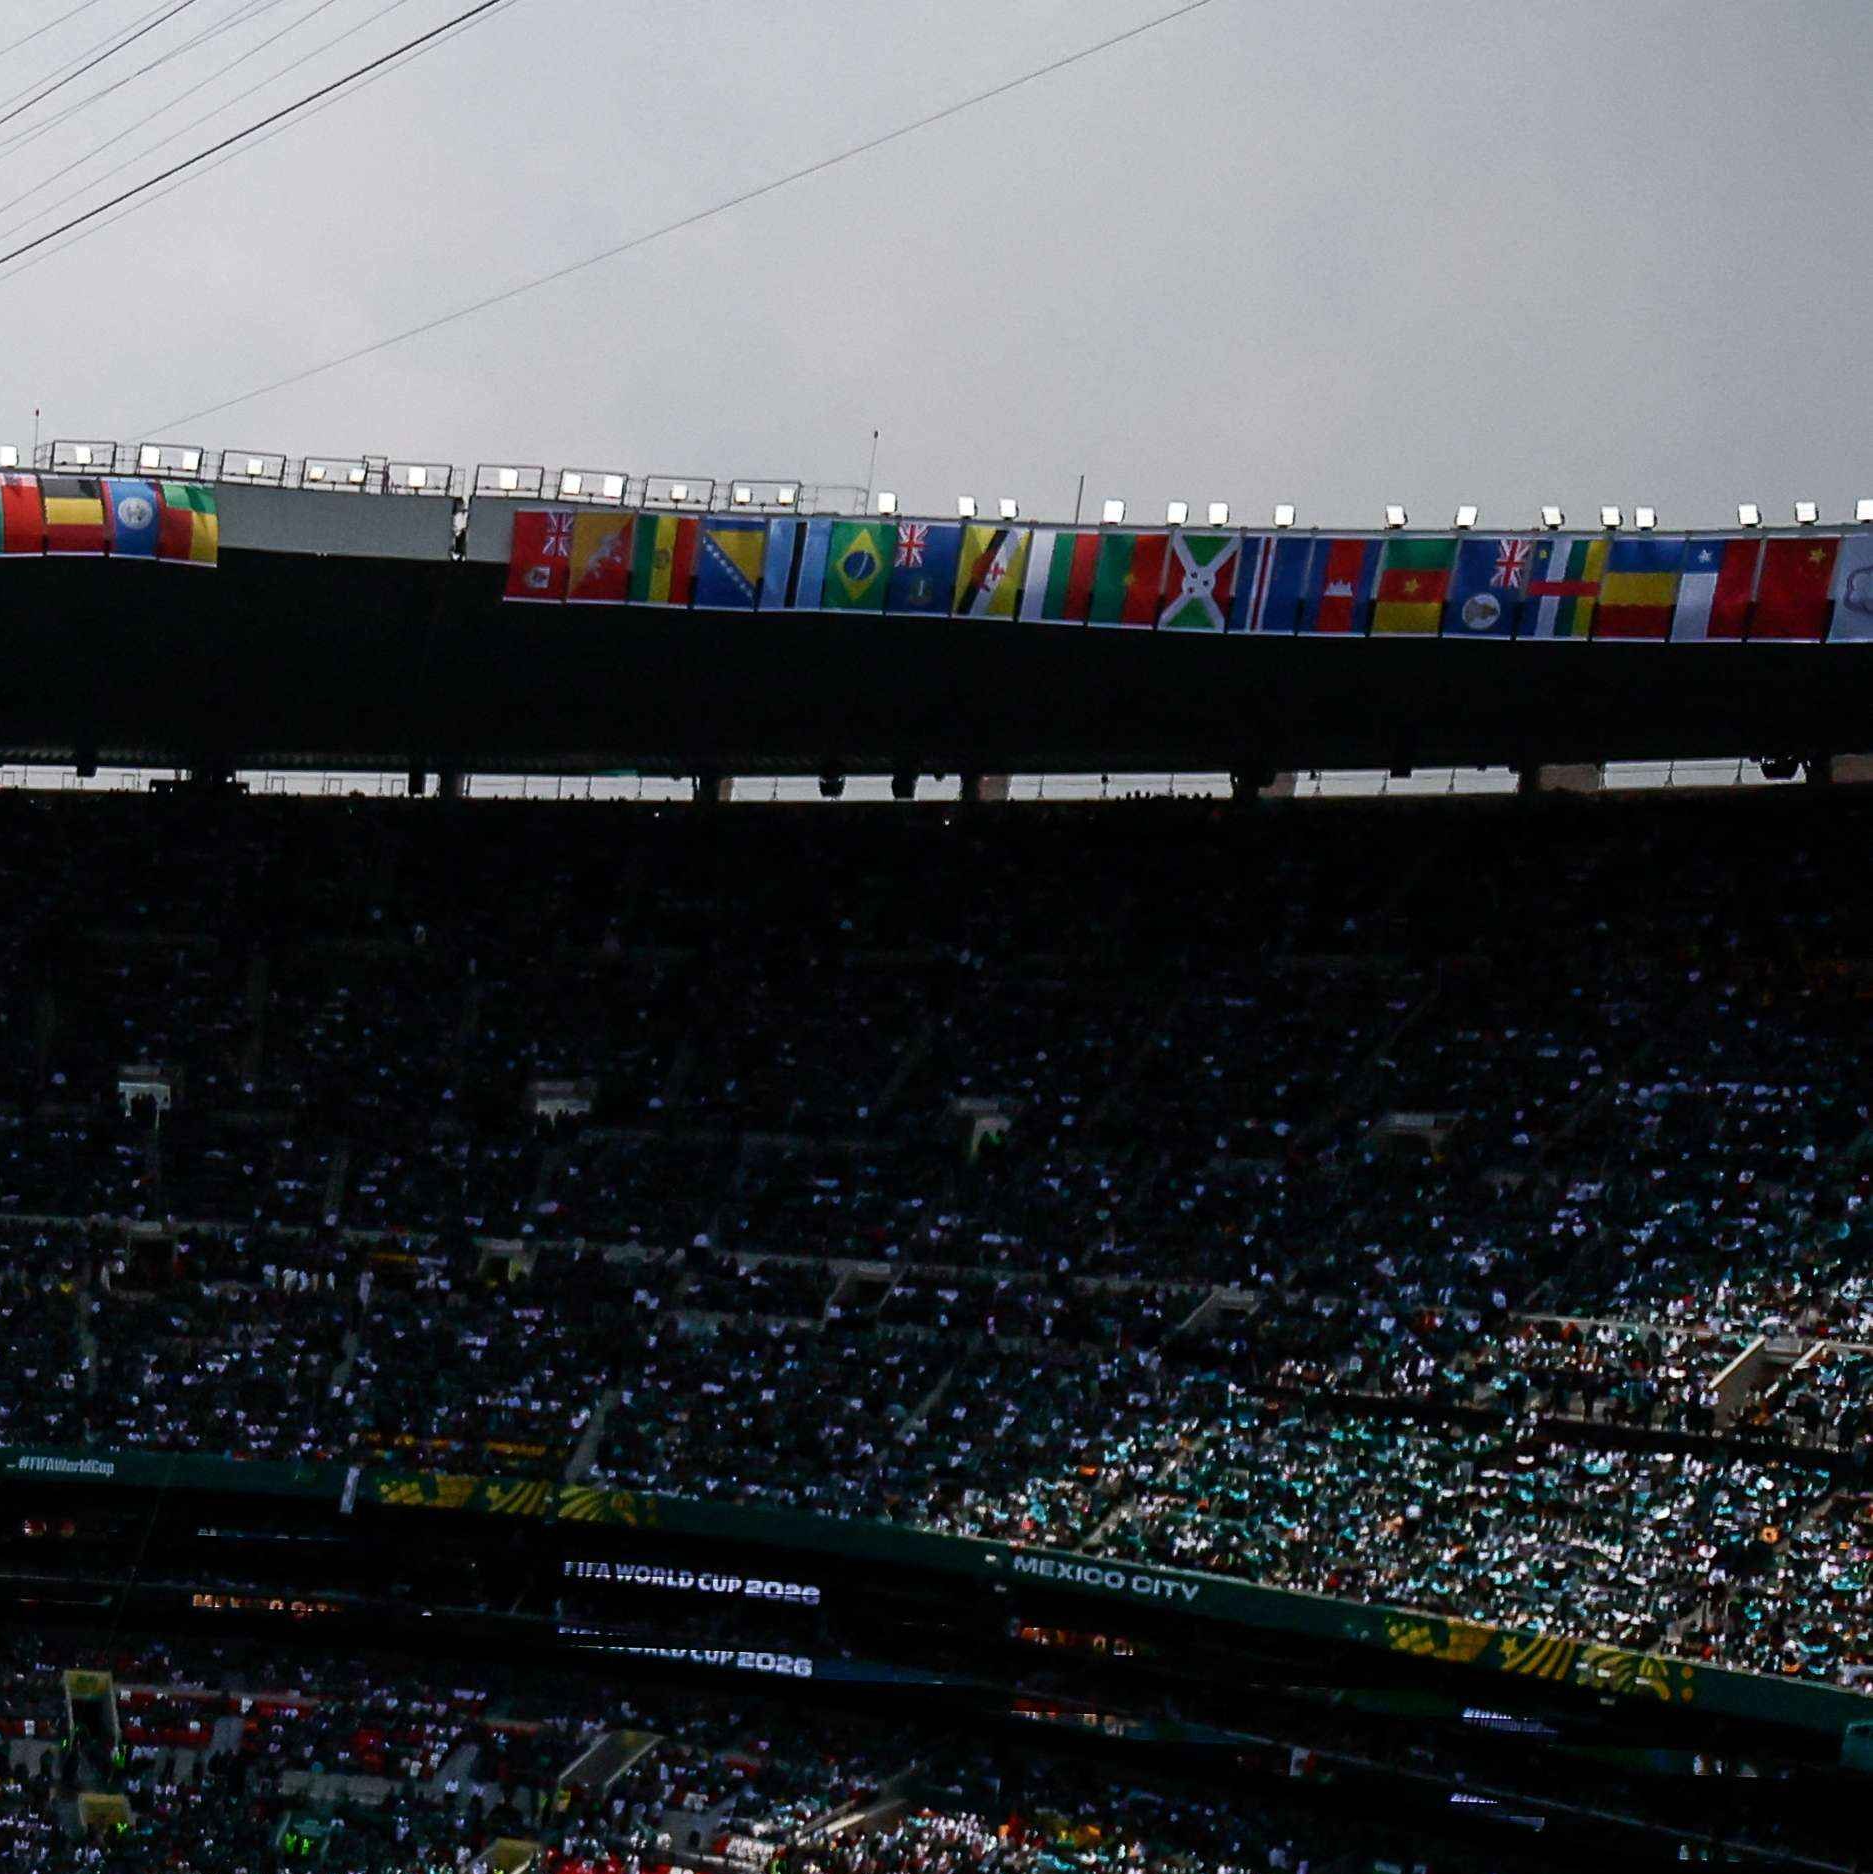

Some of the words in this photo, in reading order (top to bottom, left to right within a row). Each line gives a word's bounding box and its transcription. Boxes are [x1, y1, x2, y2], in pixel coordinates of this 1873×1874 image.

[614, 1563, 695, 1589] WORLD
[696, 1572, 742, 1593] CUP
[744, 1577, 821, 1607] 2026
[1013, 1555, 1126, 1590] MEXICO
[1131, 1574, 1200, 1602] CITY
